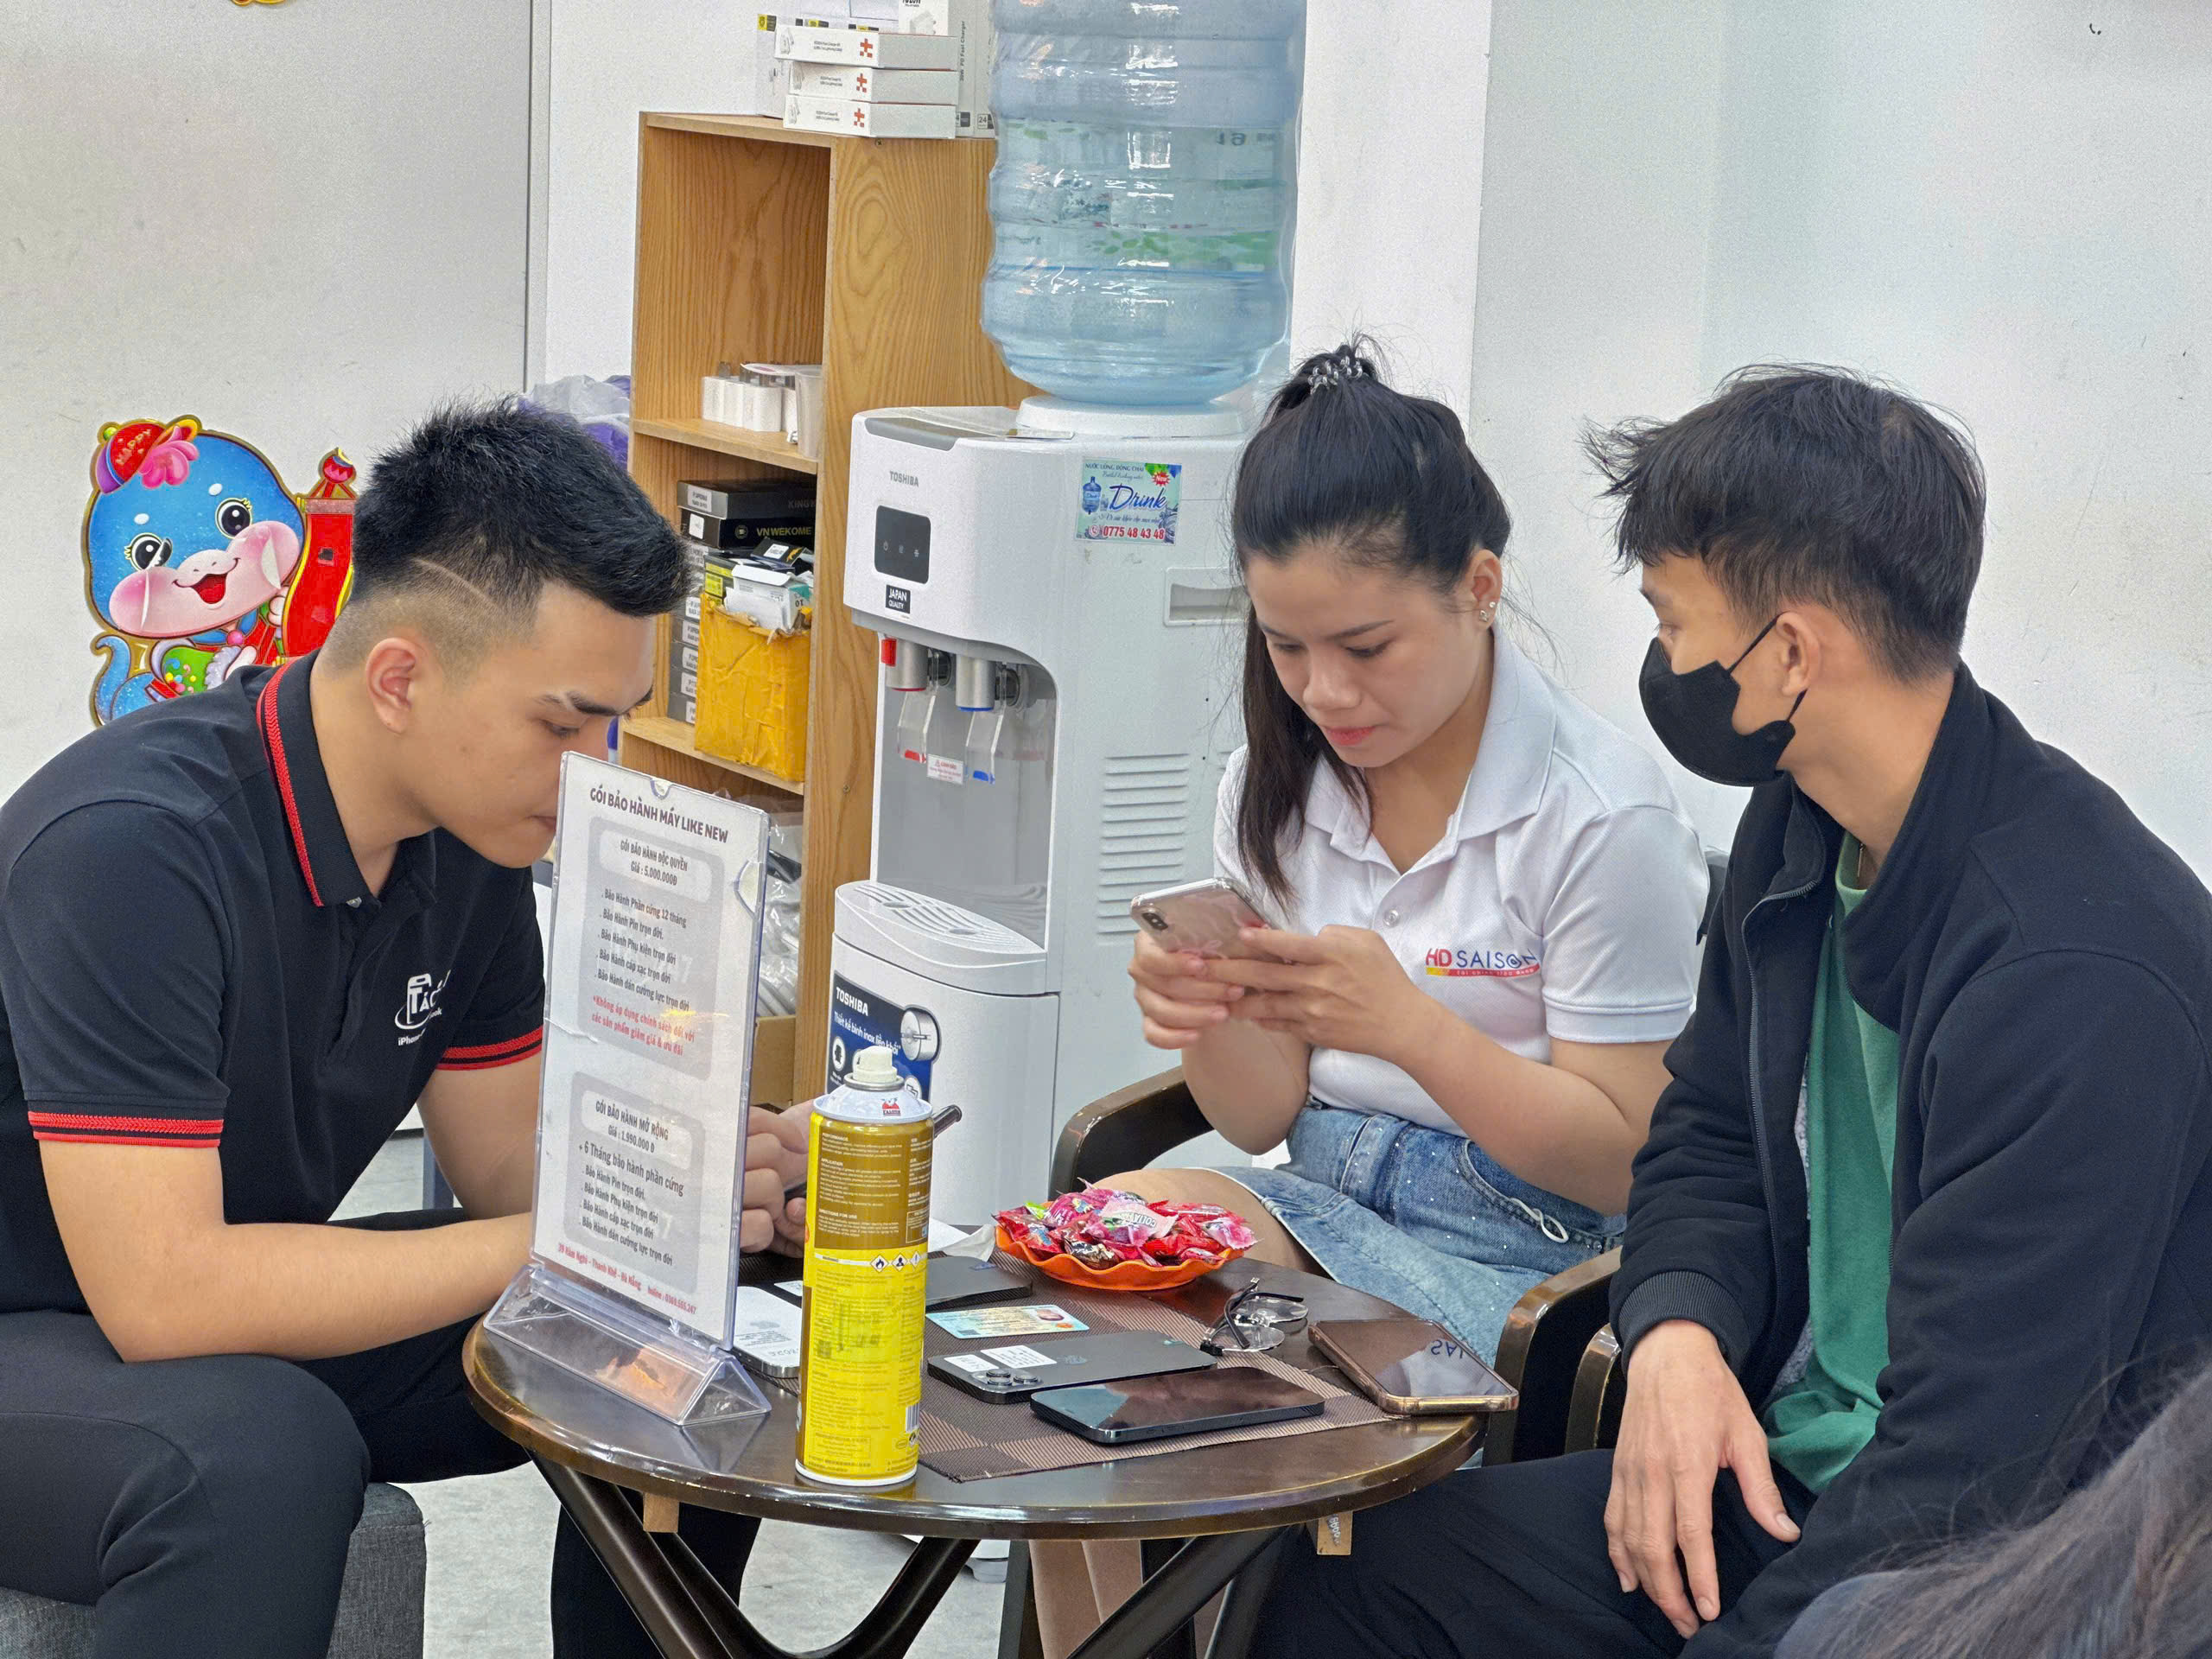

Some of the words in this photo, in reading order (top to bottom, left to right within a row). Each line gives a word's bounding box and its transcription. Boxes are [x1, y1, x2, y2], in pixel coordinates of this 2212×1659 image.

[115, 429, 151, 464] HAPPY
[889, 471, 919, 487] TOSHIBA
[788, 500, 810, 509] KING
[1109, 483, 1166, 510] Drink
[1103, 526, 1125, 537] 0775
[1127, 527, 1138, 538] 48
[1141, 528, 1151, 538] 43
[1154, 529, 1165, 539] 48
[889, 588, 907, 602] JAPAN
[889, 601, 905, 610] QUALITY
[607, 790, 628, 810] BẢO
[629, 797, 658, 821] HÀNH
[659, 807, 680, 830] MÁY
[682, 816, 703, 836] LIKE
[705, 823, 728, 843] NEW
[631, 842, 641, 856] BẢO
[642, 846, 657, 861] HÀNH
[670, 857, 688, 872] QUYỀN
[631, 861, 640, 874] Giá
[615, 893, 630, 907] Hành
[662, 909, 669, 920] 12
[670, 912, 687, 929] tháng
[614, 912, 628, 927] Hành
[629, 918, 639, 931] Pin
[639, 924, 652, 937] trọn
[612, 932, 626, 948] Hành
[652, 950, 665, 963] trọn
[1426, 948, 1452, 967] HD
[610, 953, 625, 968] Hành
[648, 967, 660, 982] trọn
[609, 972, 624, 988] Hành
[665, 995, 678, 1009] trọn
[836, 987, 868, 1016] TOSHIBA
[863, 1028, 875, 1044] inox
[607, 1103, 620, 1121] BẢO
[620, 1108, 638, 1128] HÀNH
[651, 1122, 669, 1141] RỘNG
[584, 1141, 589, 1154] 6
[590, 1142, 612, 1166] Tháng
[612, 1153, 625, 1170] bảo
[626, 1158, 645, 1179] hành
[645, 1168, 664, 1186] phần
[664, 1176, 684, 1198] cứng
[611, 1176, 620, 1190] Pin
[621, 1181, 634, 1196] trọn
[635, 1205, 648, 1220] trọn
[631, 1221, 643, 1236] trọn
[649, 1248, 662, 1263] trọn
